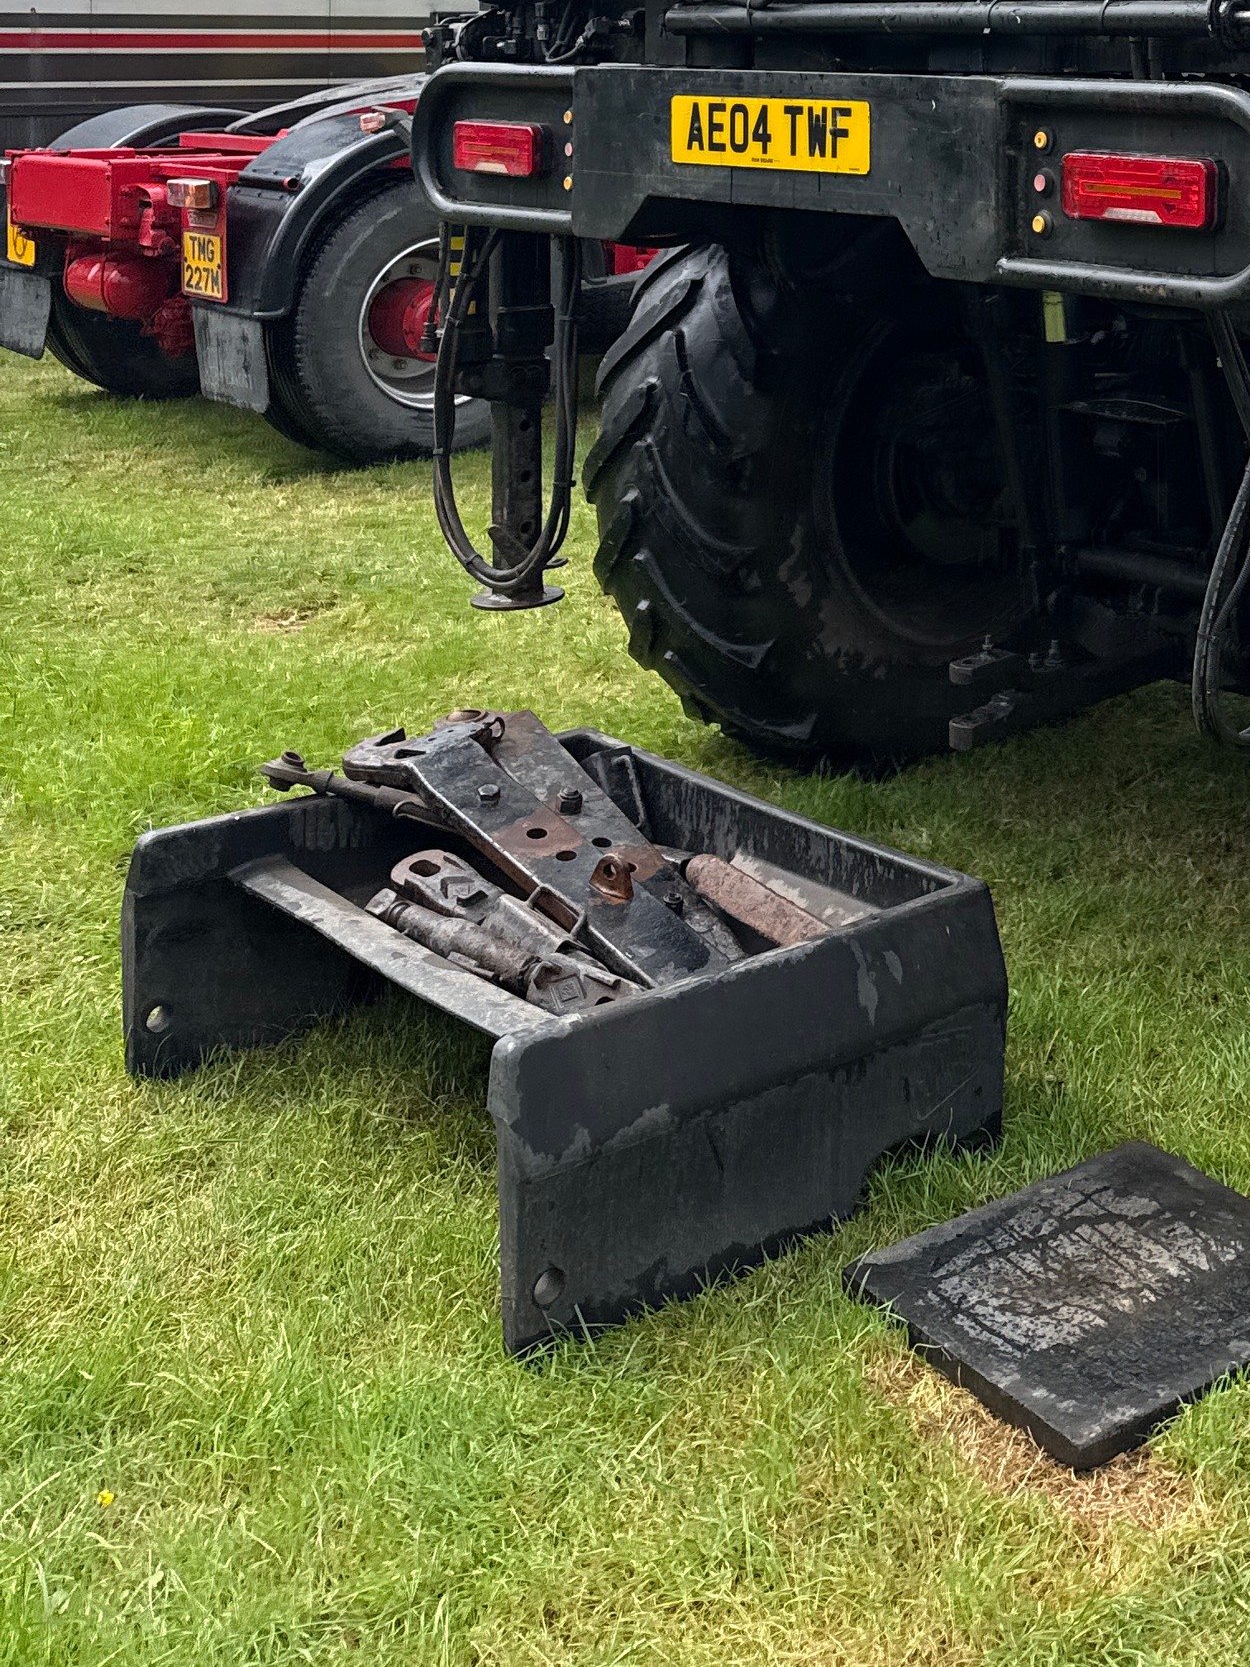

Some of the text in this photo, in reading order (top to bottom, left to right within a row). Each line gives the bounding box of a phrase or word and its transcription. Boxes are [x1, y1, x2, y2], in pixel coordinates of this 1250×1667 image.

[687, 102, 852, 159] AE04 TWF
[189, 236, 215, 263] TMG
[186, 264, 221, 294] 227M
